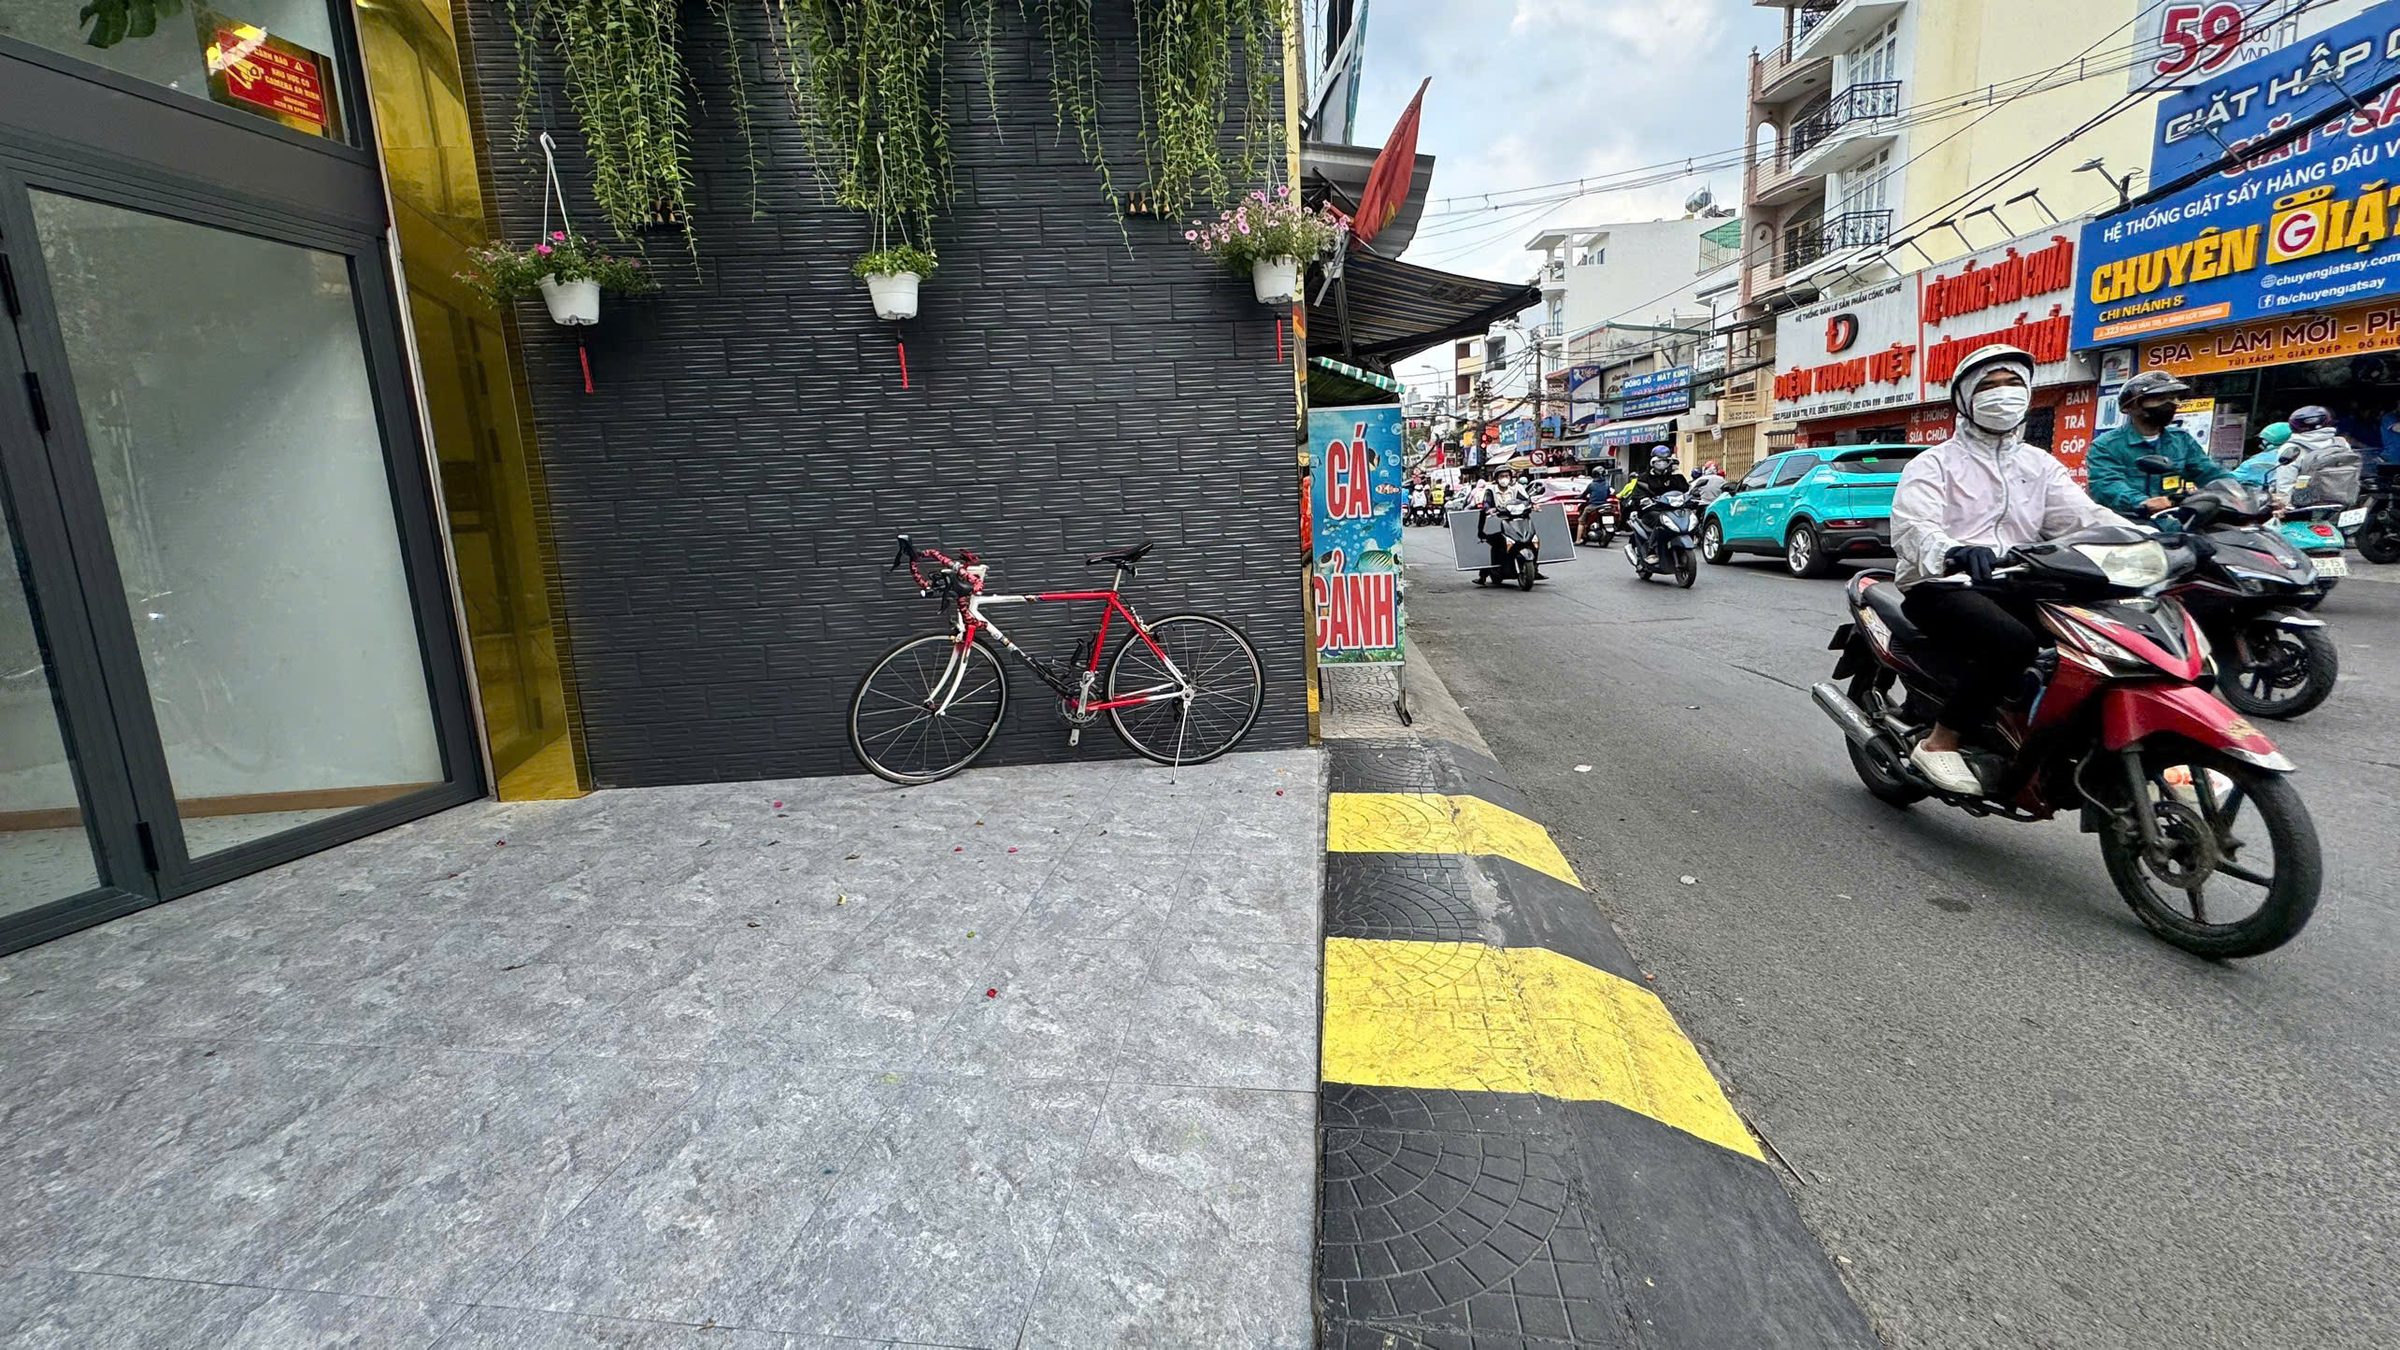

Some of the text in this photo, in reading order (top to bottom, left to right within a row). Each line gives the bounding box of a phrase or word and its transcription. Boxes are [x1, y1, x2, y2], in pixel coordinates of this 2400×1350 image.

[2154, 2, 2246, 77] 59
[2103, 221, 2122, 243] HỆ
[2126, 207, 2180, 236] THỐNG
[2184, 193, 2224, 218] GIẶT
[2226, 178, 2263, 206] SẤY
[2266, 162, 2326, 194] HÀNG
[2331, 143, 2378, 175] ĐẦU
[2090, 224, 2262, 305] CHUYÊN
[2099, 308, 2120, 323] CHI
[2122, 297, 2171, 318] NHÁNH
[2148, 342, 2193, 367] SPA
[2217, 328, 2272, 358] LÀM
[2281, 313, 2338, 348] MỚI
[2060, 436, 2086, 454] GÓP
[2064, 409, 2086, 430] TRẢ
[1326, 421, 1373, 521] CÁ
[1313, 546, 1398, 652] CẢNH
